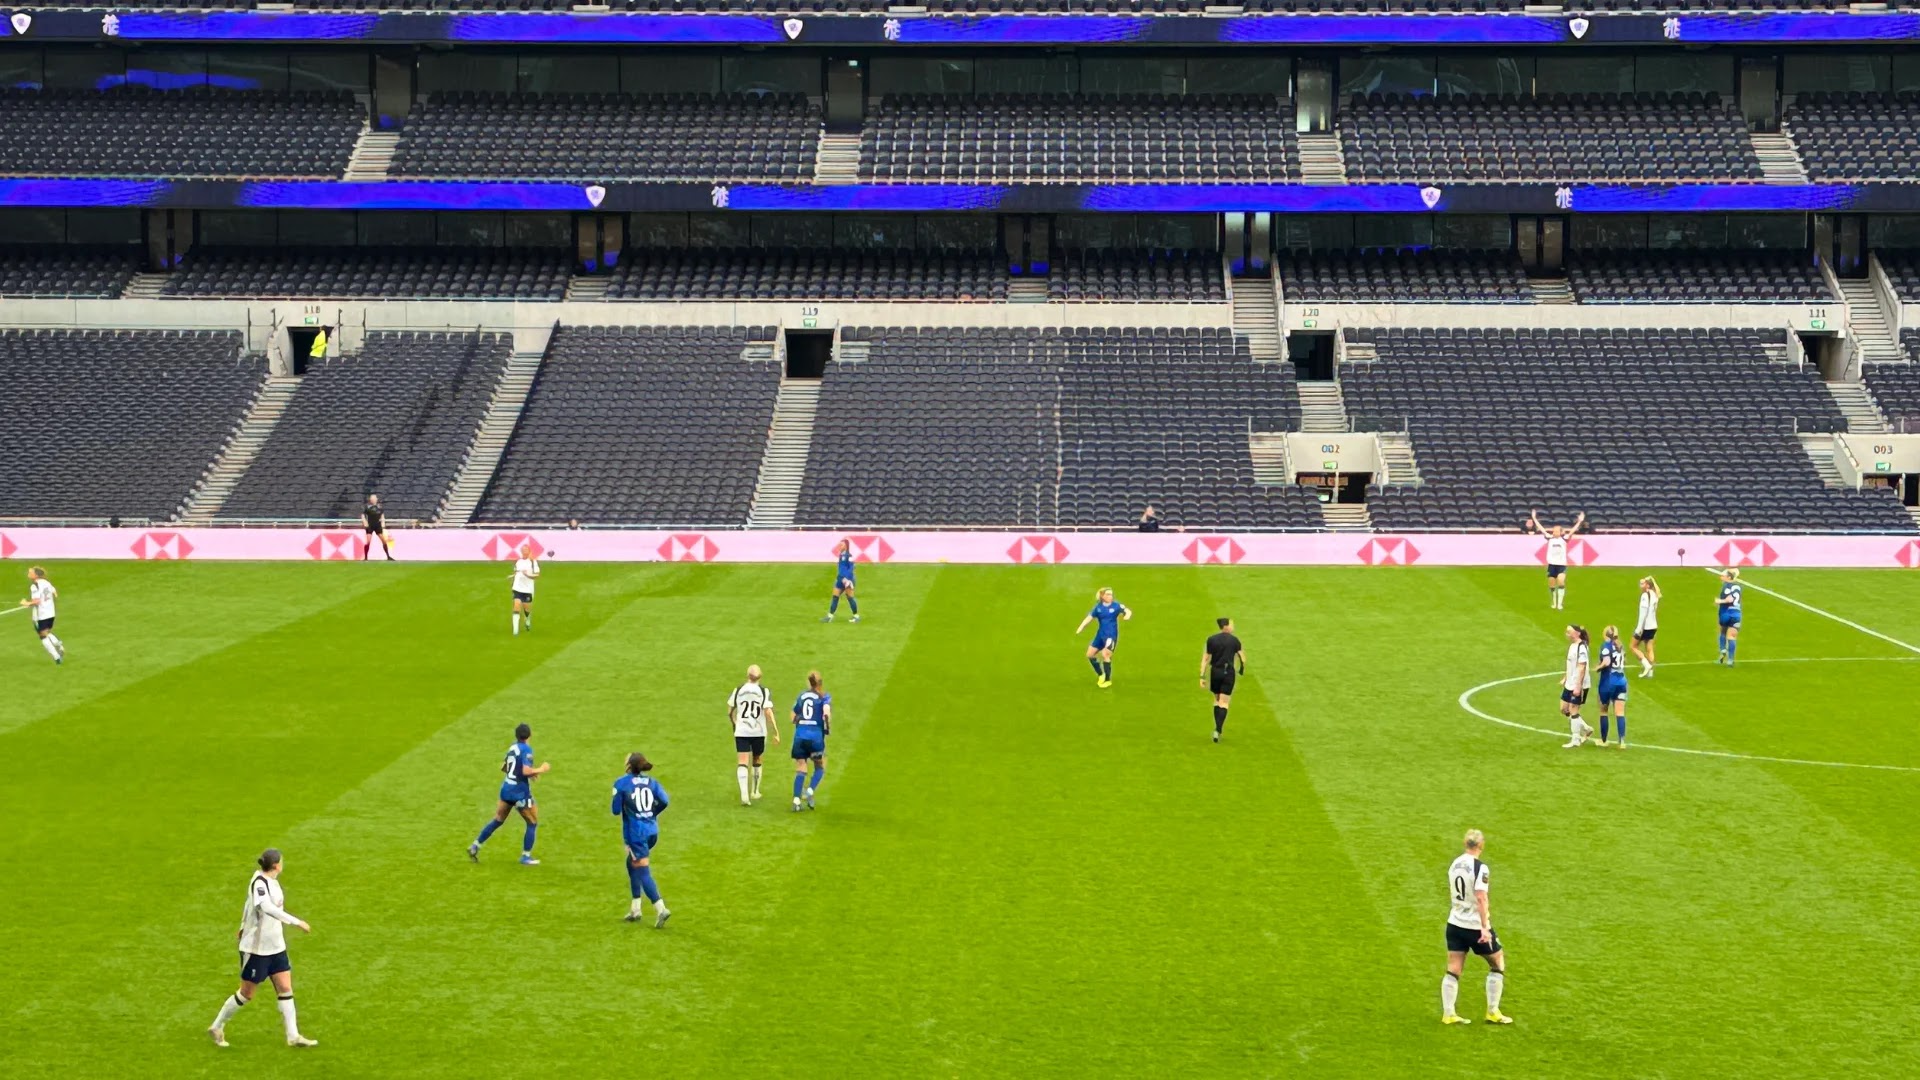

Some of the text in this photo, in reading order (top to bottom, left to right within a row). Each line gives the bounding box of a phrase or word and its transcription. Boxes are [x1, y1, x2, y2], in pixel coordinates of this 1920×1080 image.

[802, 307, 819, 316] 119
[1303, 307, 1319, 317] 120
[1321, 444, 1340, 454] 002
[1873, 445, 1893, 454] 003
[802, 698, 814, 720] 6
[631, 787, 654, 812] 10
[1454, 875, 1466, 901] 9
